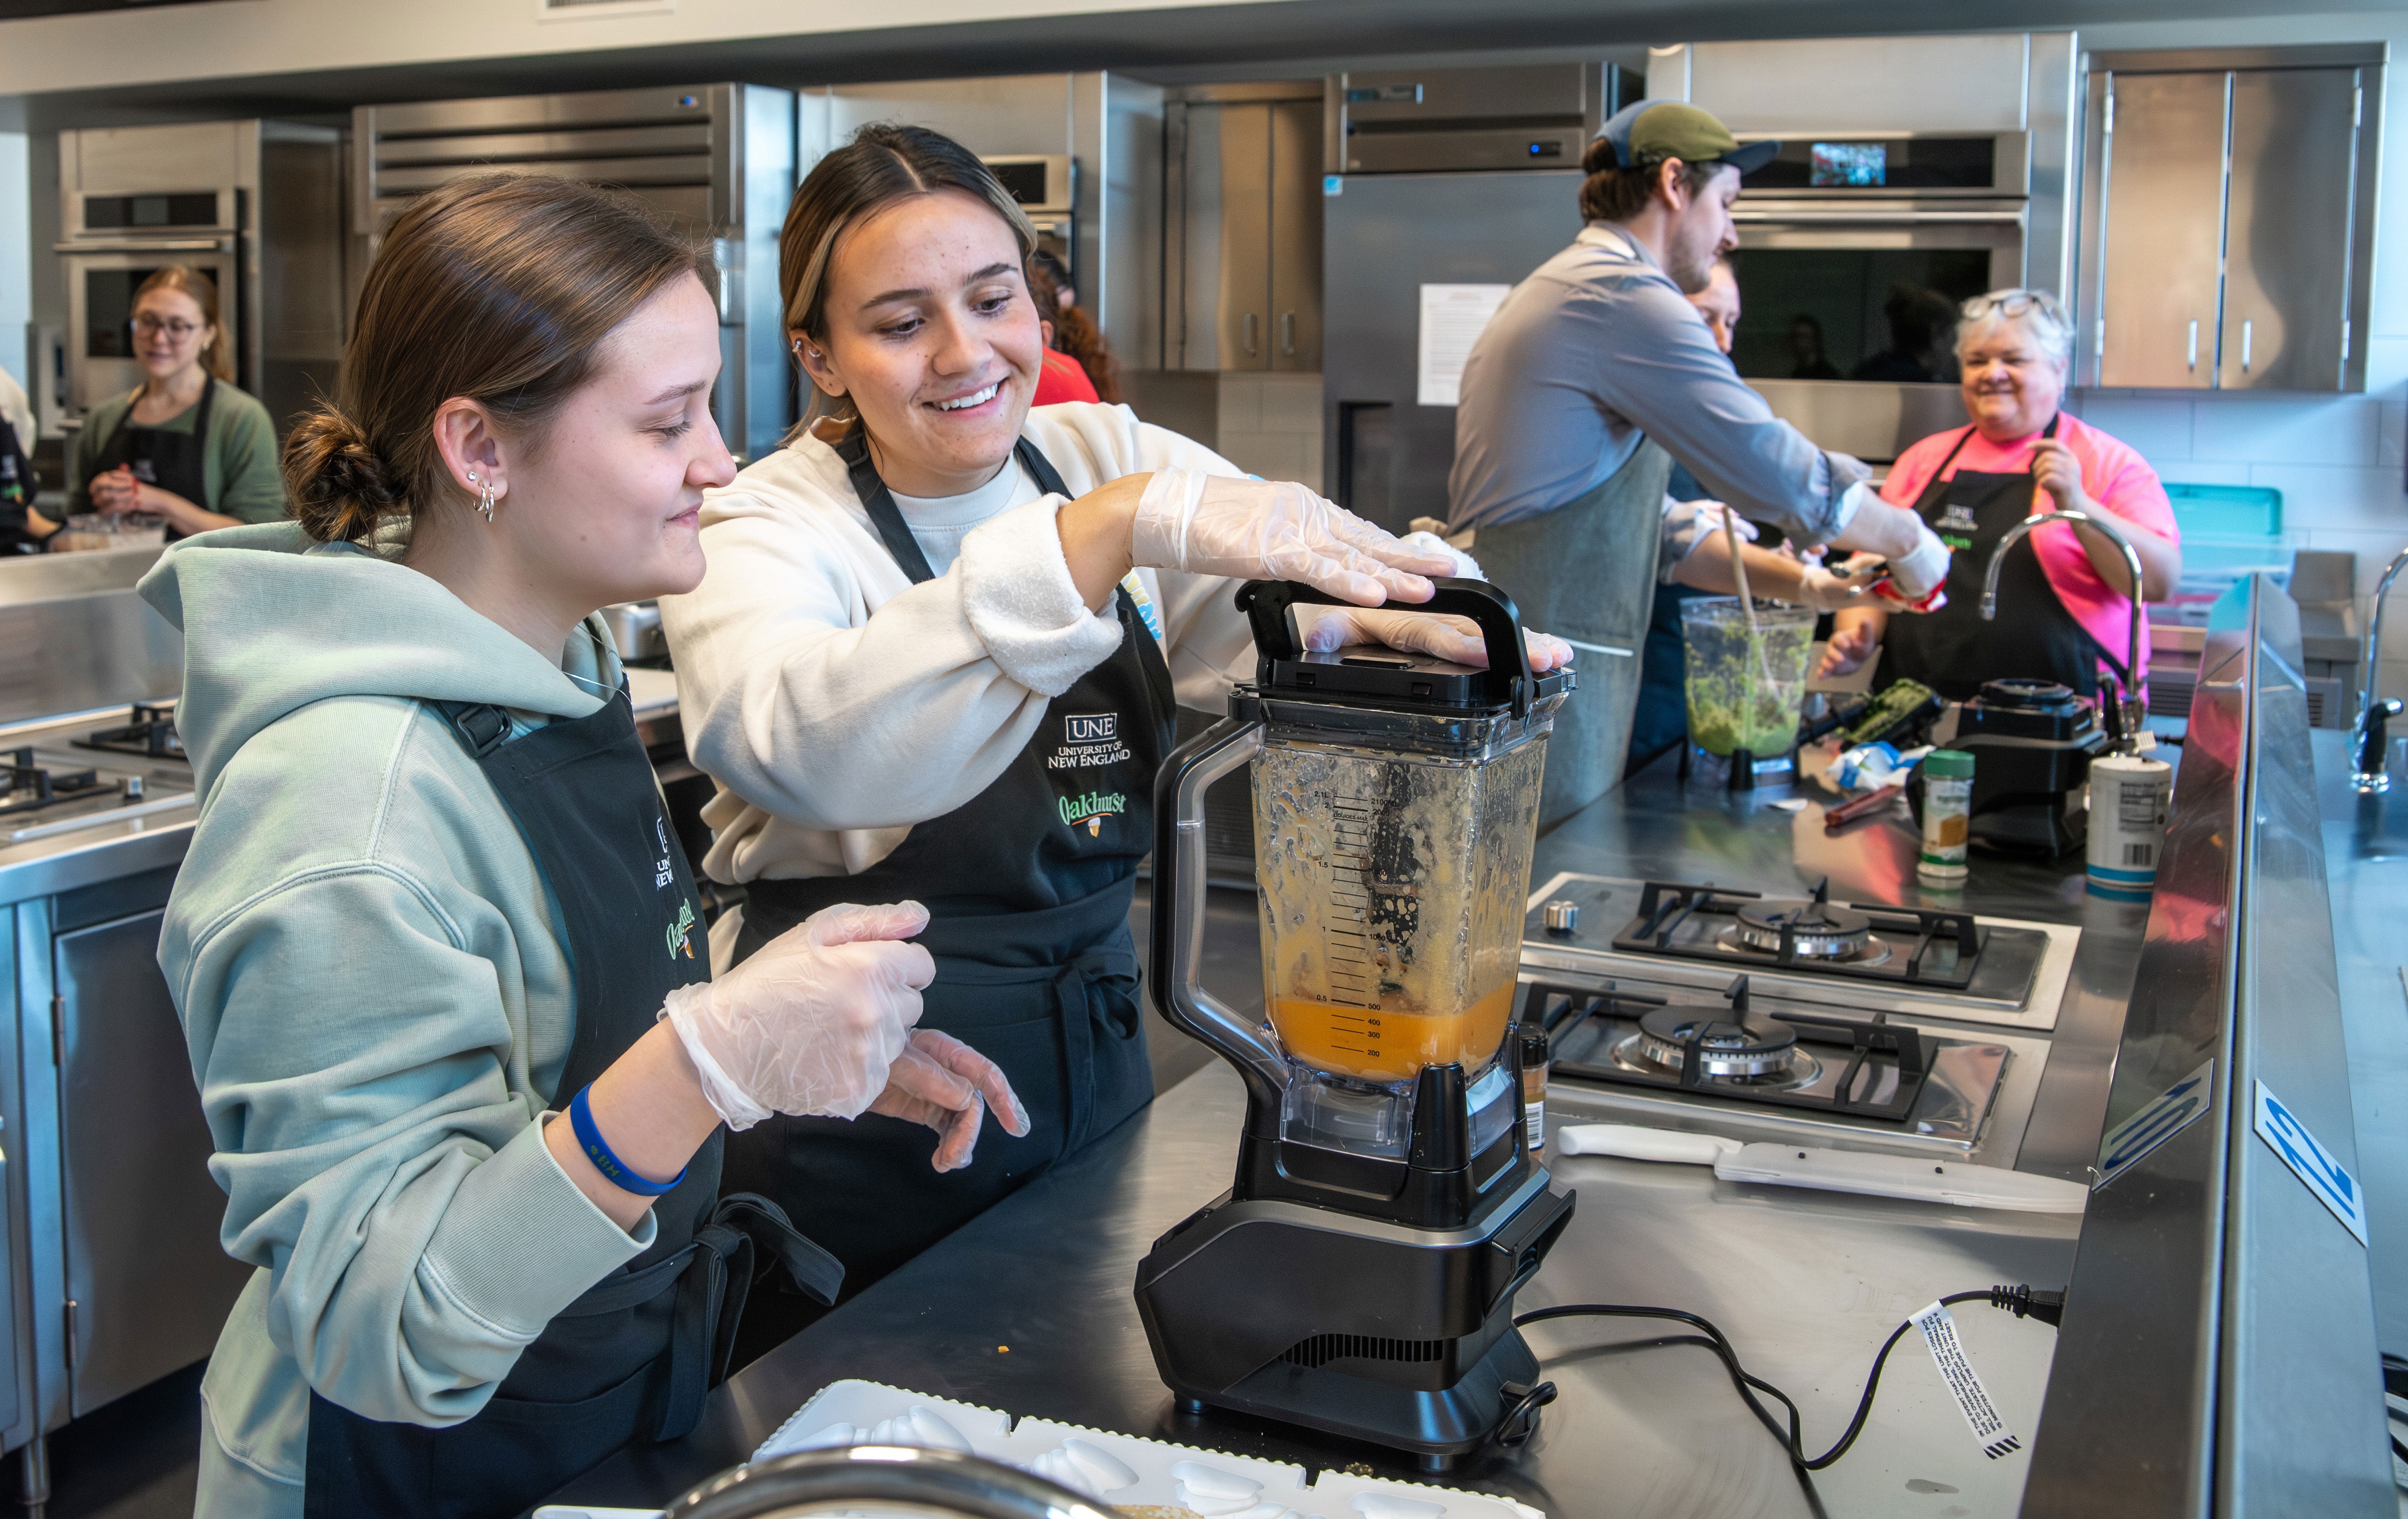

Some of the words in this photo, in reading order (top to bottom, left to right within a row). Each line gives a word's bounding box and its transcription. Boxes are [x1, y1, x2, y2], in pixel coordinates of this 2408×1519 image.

[1072, 718, 1114, 738] UNE
[1058, 743, 1113, 756] UNIVERSITY
[1114, 741, 1122, 750] OF
[1048, 755, 1079, 769] NEW
[1080, 749, 1130, 767] ENGLAND
[1058, 791, 1126, 826] Oakhurst
[1369, 932, 1386, 941] 1000
[2266, 1097, 2356, 1220] 12
[1945, 1321, 1953, 1341] RESET.
[1928, 1332, 1937, 1350] LOSES
[1933, 1325, 1945, 1353] THERMAL
[1952, 1342, 1957, 1350] TO
[1936, 1352, 1944, 1366] UNIT
[1956, 1352, 1966, 1367] FUSE
[1954, 1361, 1969, 1385] UNPLUG
[1965, 1368, 1973, 1380] THE
[1950, 1380, 1960, 1395] THAT
[1973, 1381, 1981, 1393] FOR
[1959, 1396, 1972, 1416] EVENT
[1980, 1394, 1997, 1421] MINUTES
[1971, 1417, 1979, 1429] THE
[1975, 1412, 1982, 1420] TO
[1981, 1421, 1990, 1434] DUE
